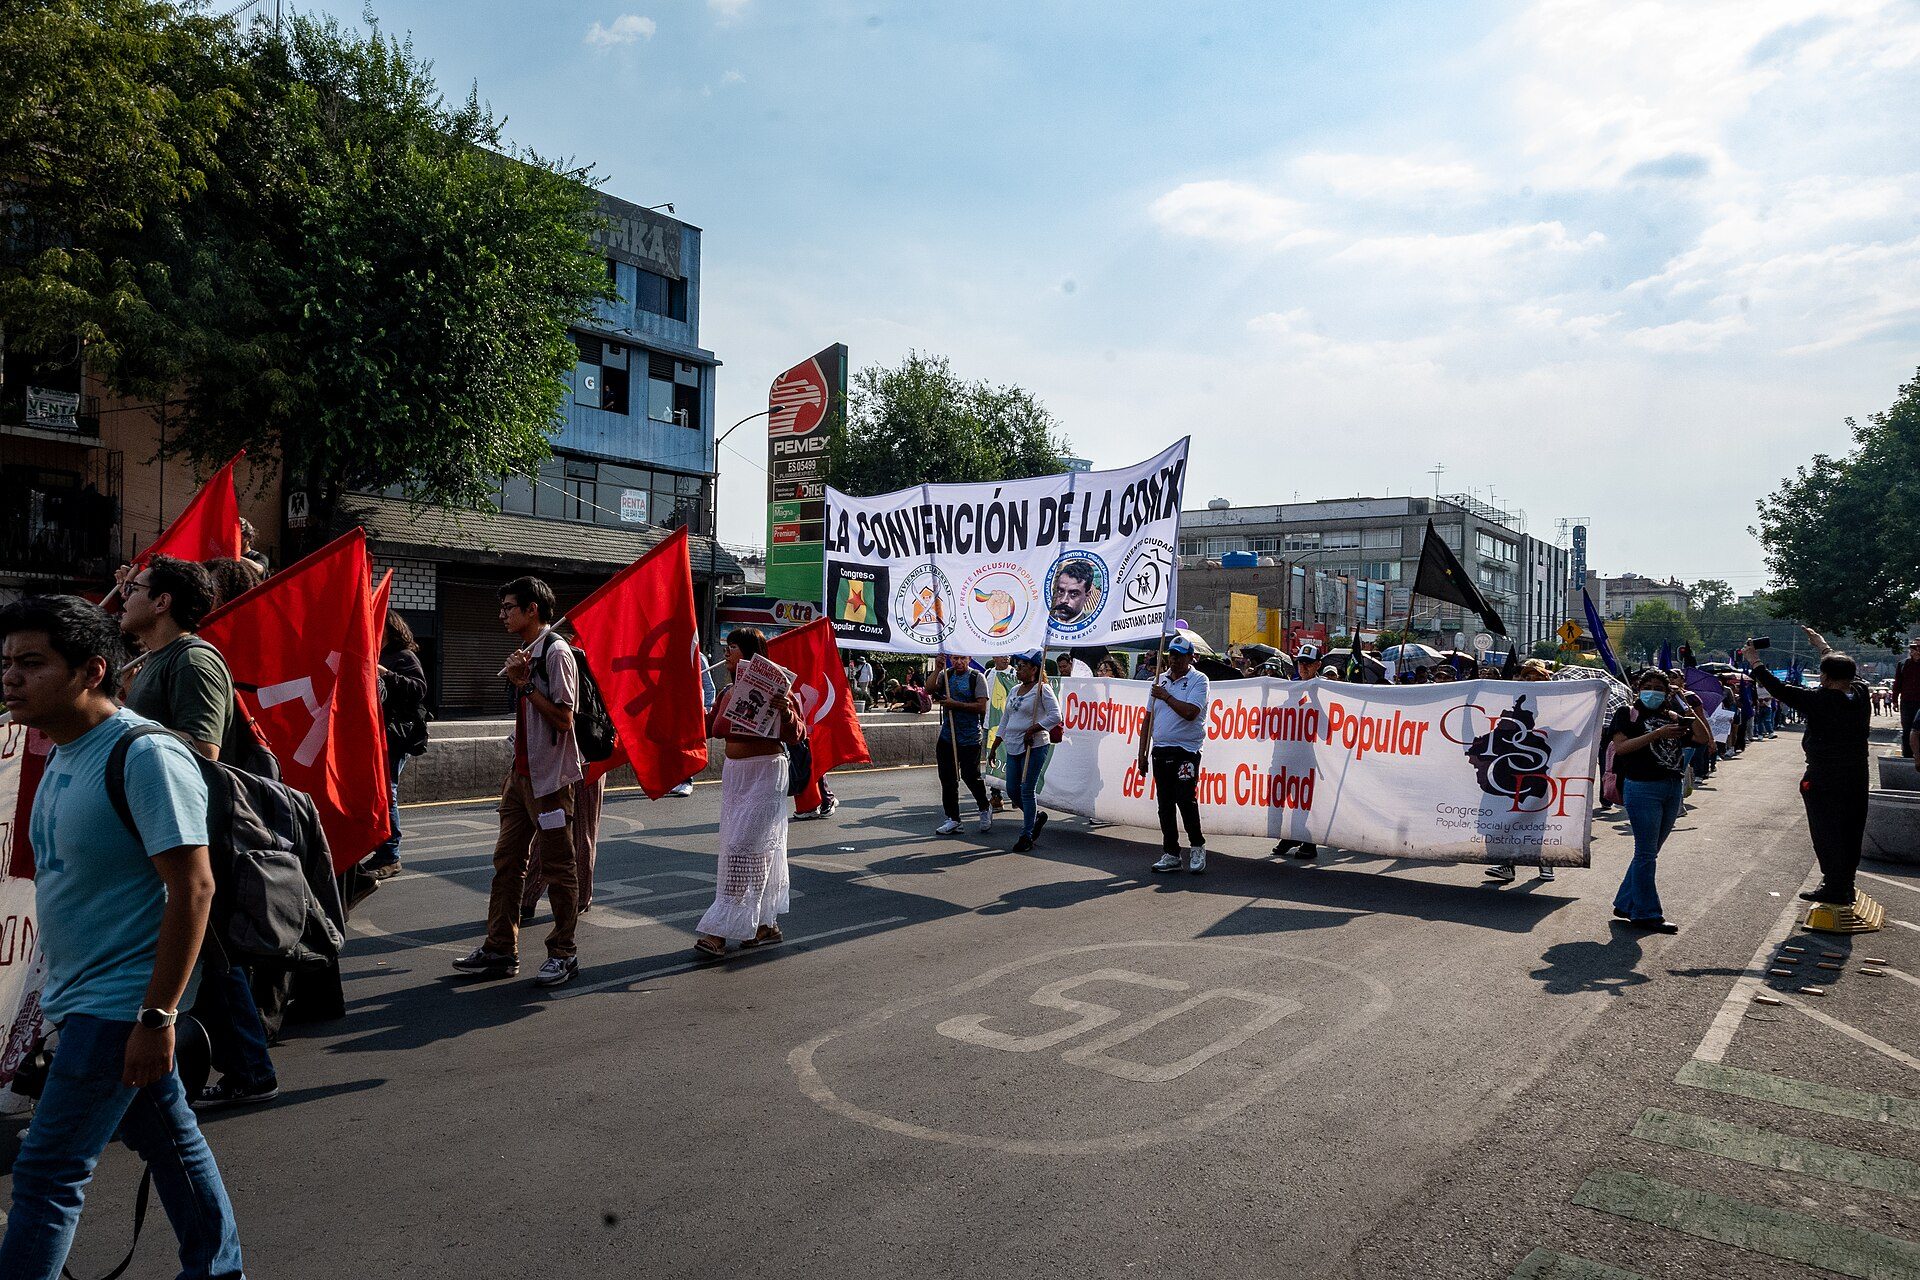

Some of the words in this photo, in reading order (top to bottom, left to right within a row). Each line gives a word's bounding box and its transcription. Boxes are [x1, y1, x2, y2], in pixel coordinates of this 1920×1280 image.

[28, 399, 77, 415] VENTA
[774, 435, 831, 456] PEMEX
[788, 462, 796, 472] ES
[622, 497, 645, 510] RENTA
[826, 503, 850, 554] LA
[856, 488, 1028, 559] CONVENCIÓN
[1036, 492, 1075, 547] DE
[1079, 489, 1112, 543] LA
[1118, 459, 1185, 537] CDMX
[775, 509, 794, 519] Magna
[288, 519, 307, 529] TECATE
[774, 530, 796, 538] Premium
[1116, 539, 1143, 585] MOVIMIENTO
[1144, 537, 1174, 555] CIUDAD
[840, 567, 875, 580] Congreso
[899, 567, 923, 598] VIVIENDA
[929, 565, 952, 596] LIBERTAD
[960, 576, 973, 607] FRENTE
[973, 562, 1017, 577] INCLUSIVO
[1017, 566, 1039, 601] POPULAR
[776, 603, 812, 620] extra
[1147, 611, 1165, 624] CARR
[860, 625, 884, 636] CDMX
[898, 616, 915, 638] PARA
[1207, 695, 1319, 743] Soberanía
[1326, 702, 1429, 761] Popular
[1122, 759, 1146, 799] de
[1234, 763, 1315, 811] Ciudad
[1436, 802, 1493, 818] Congreso
[1436, 817, 1471, 830] Popular,
[1474, 820, 1503, 831] Social
[1503, 824, 1510, 833] y
[1512, 821, 1563, 832] Ciudadano
[1470, 835, 1485, 843] del
[1485, 835, 1521, 846] Distrito
[1523, 836, 1562, 846] Federal
